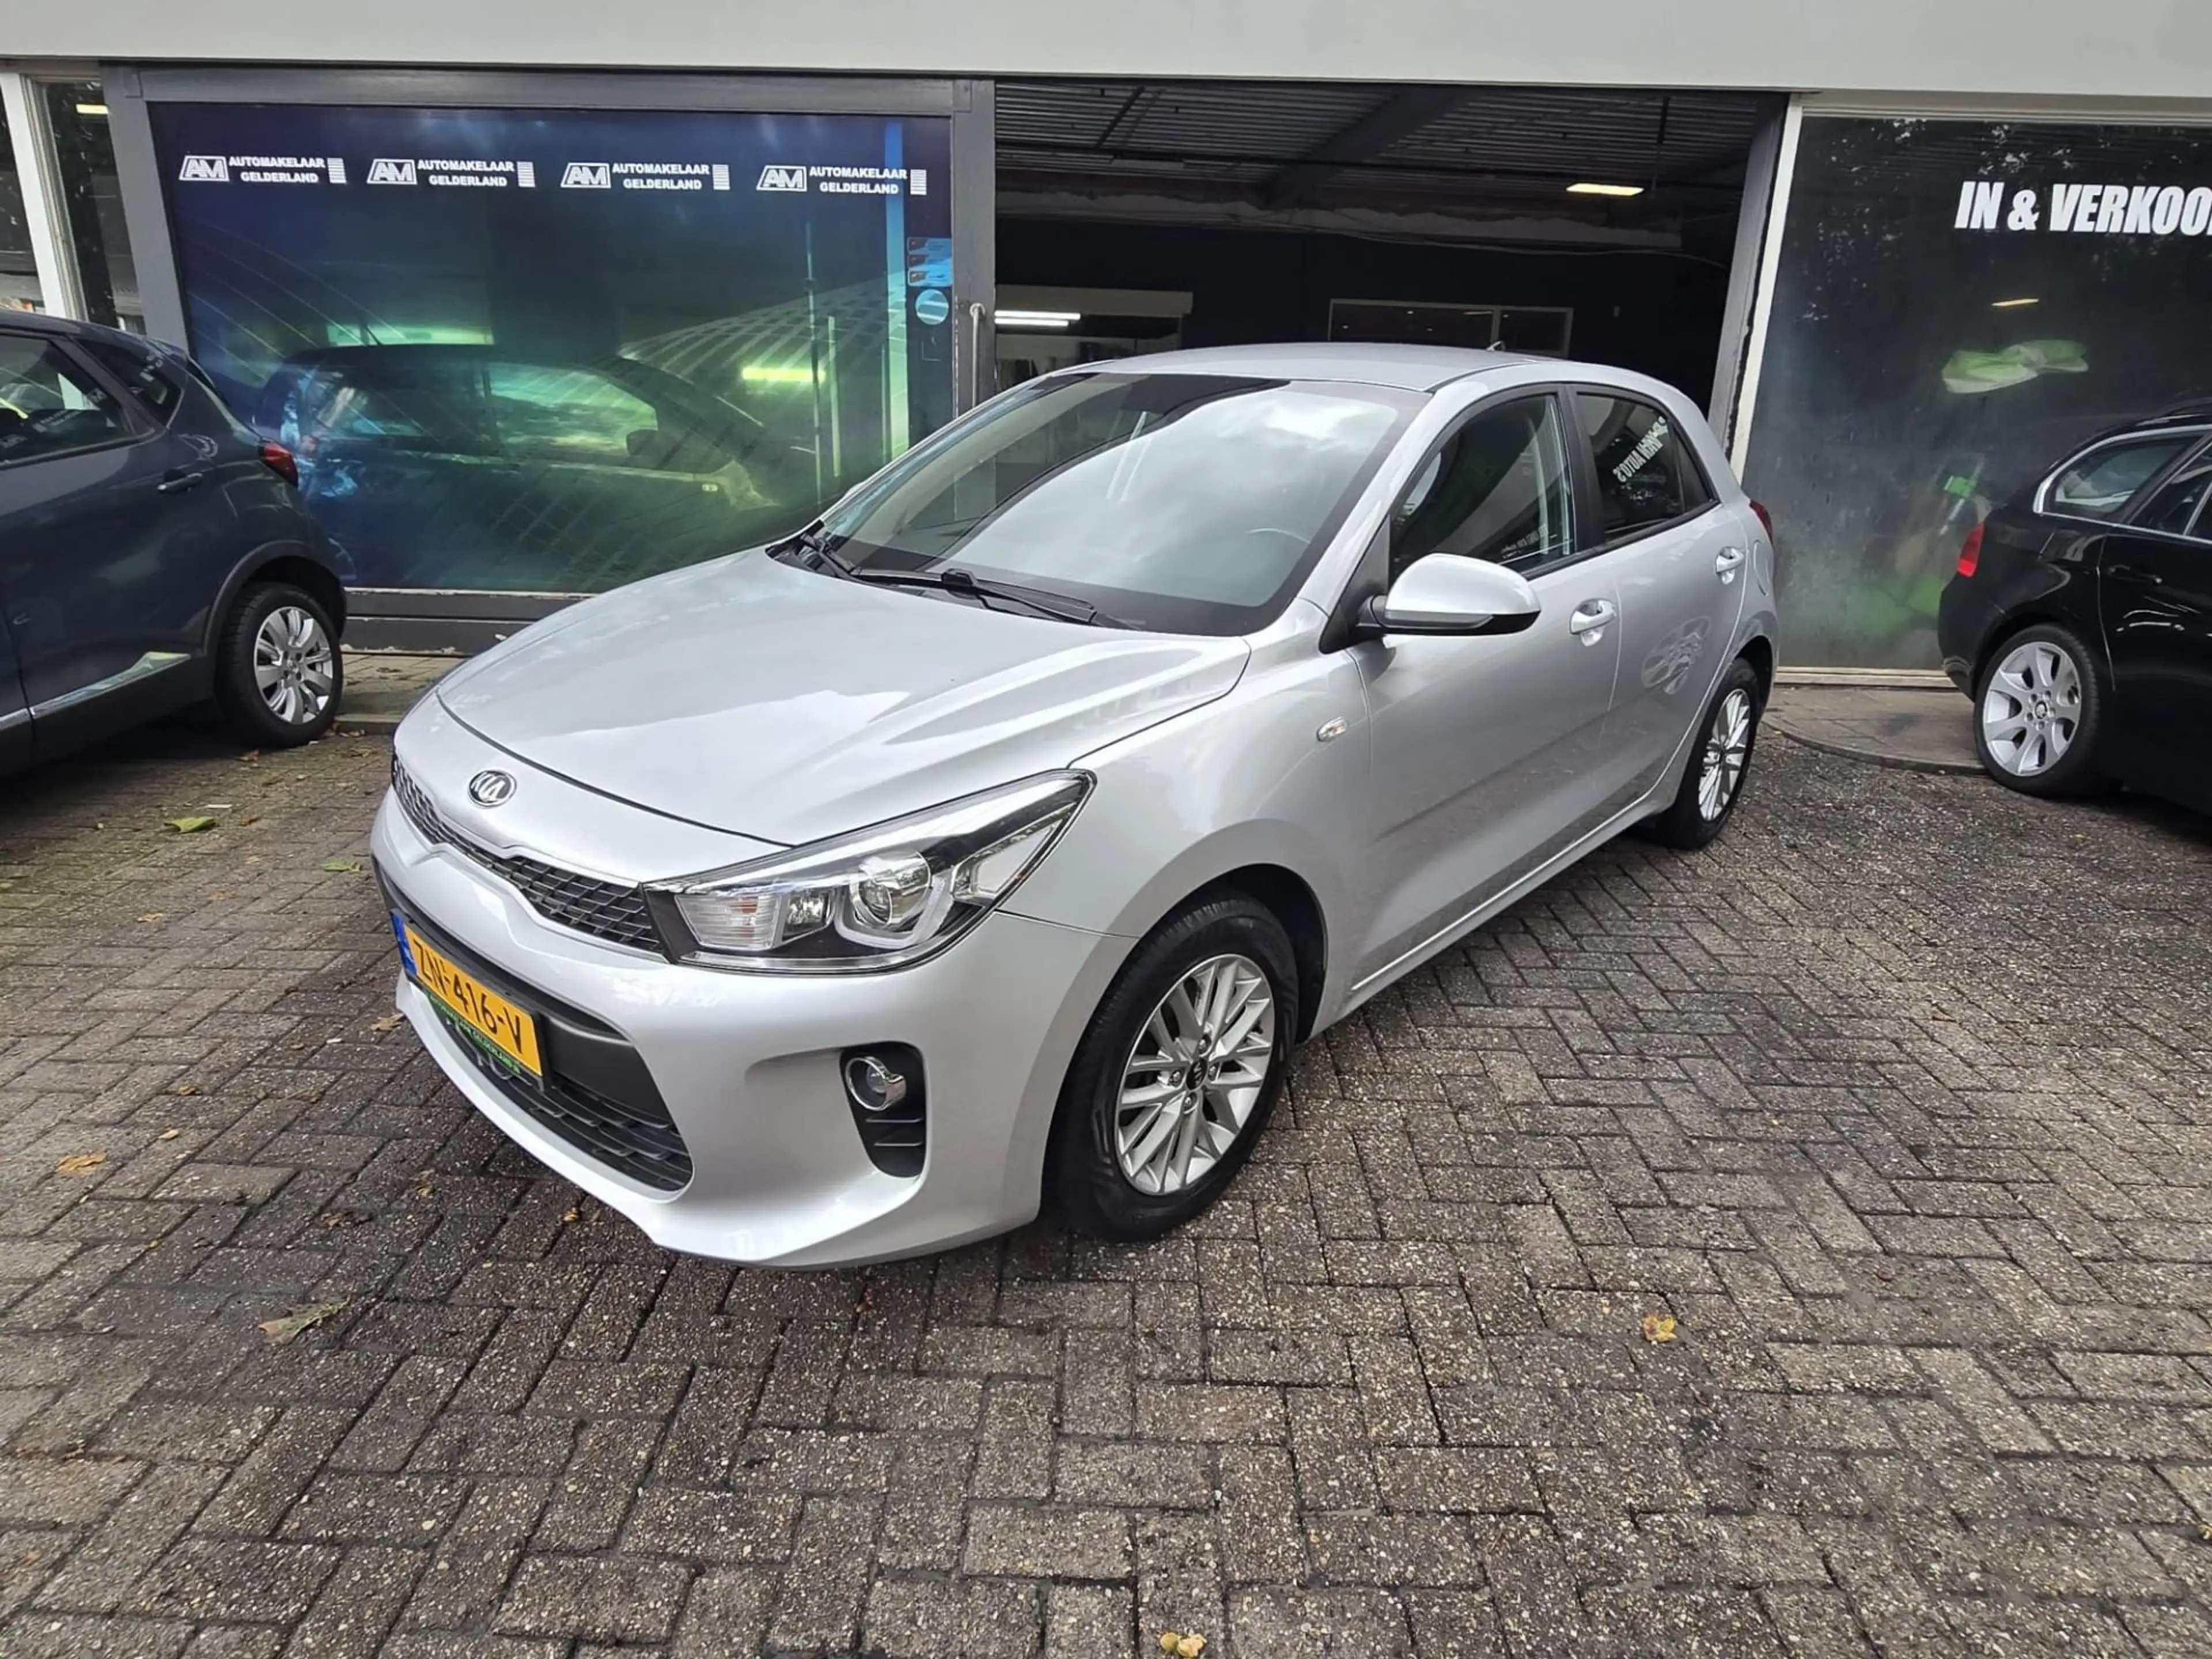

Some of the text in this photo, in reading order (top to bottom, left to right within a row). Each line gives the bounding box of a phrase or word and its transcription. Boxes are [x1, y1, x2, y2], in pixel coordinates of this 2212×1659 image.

[184, 158, 225, 179] AM
[229, 156, 325, 168] AUTOMAKELAAR
[418, 160, 514, 172] AUTOMAKELAAR
[373, 161, 412, 183] AM
[567, 166, 607, 185] AM
[612, 163, 710, 175] AUTOMAKELAAR
[809, 166, 907, 180] AUTOMAKELAAR
[240, 172, 320, 183] GELDERLAND
[429, 175, 507, 187] GELDERLAND
[623, 178, 702, 190] GELDERLAND
[763, 169, 803, 188] AM
[819, 182, 899, 194] GELDERLAND
[1955, 181, 2212, 236] IN & VERKOO
[413, 938, 522, 1055] ZN-416-V
